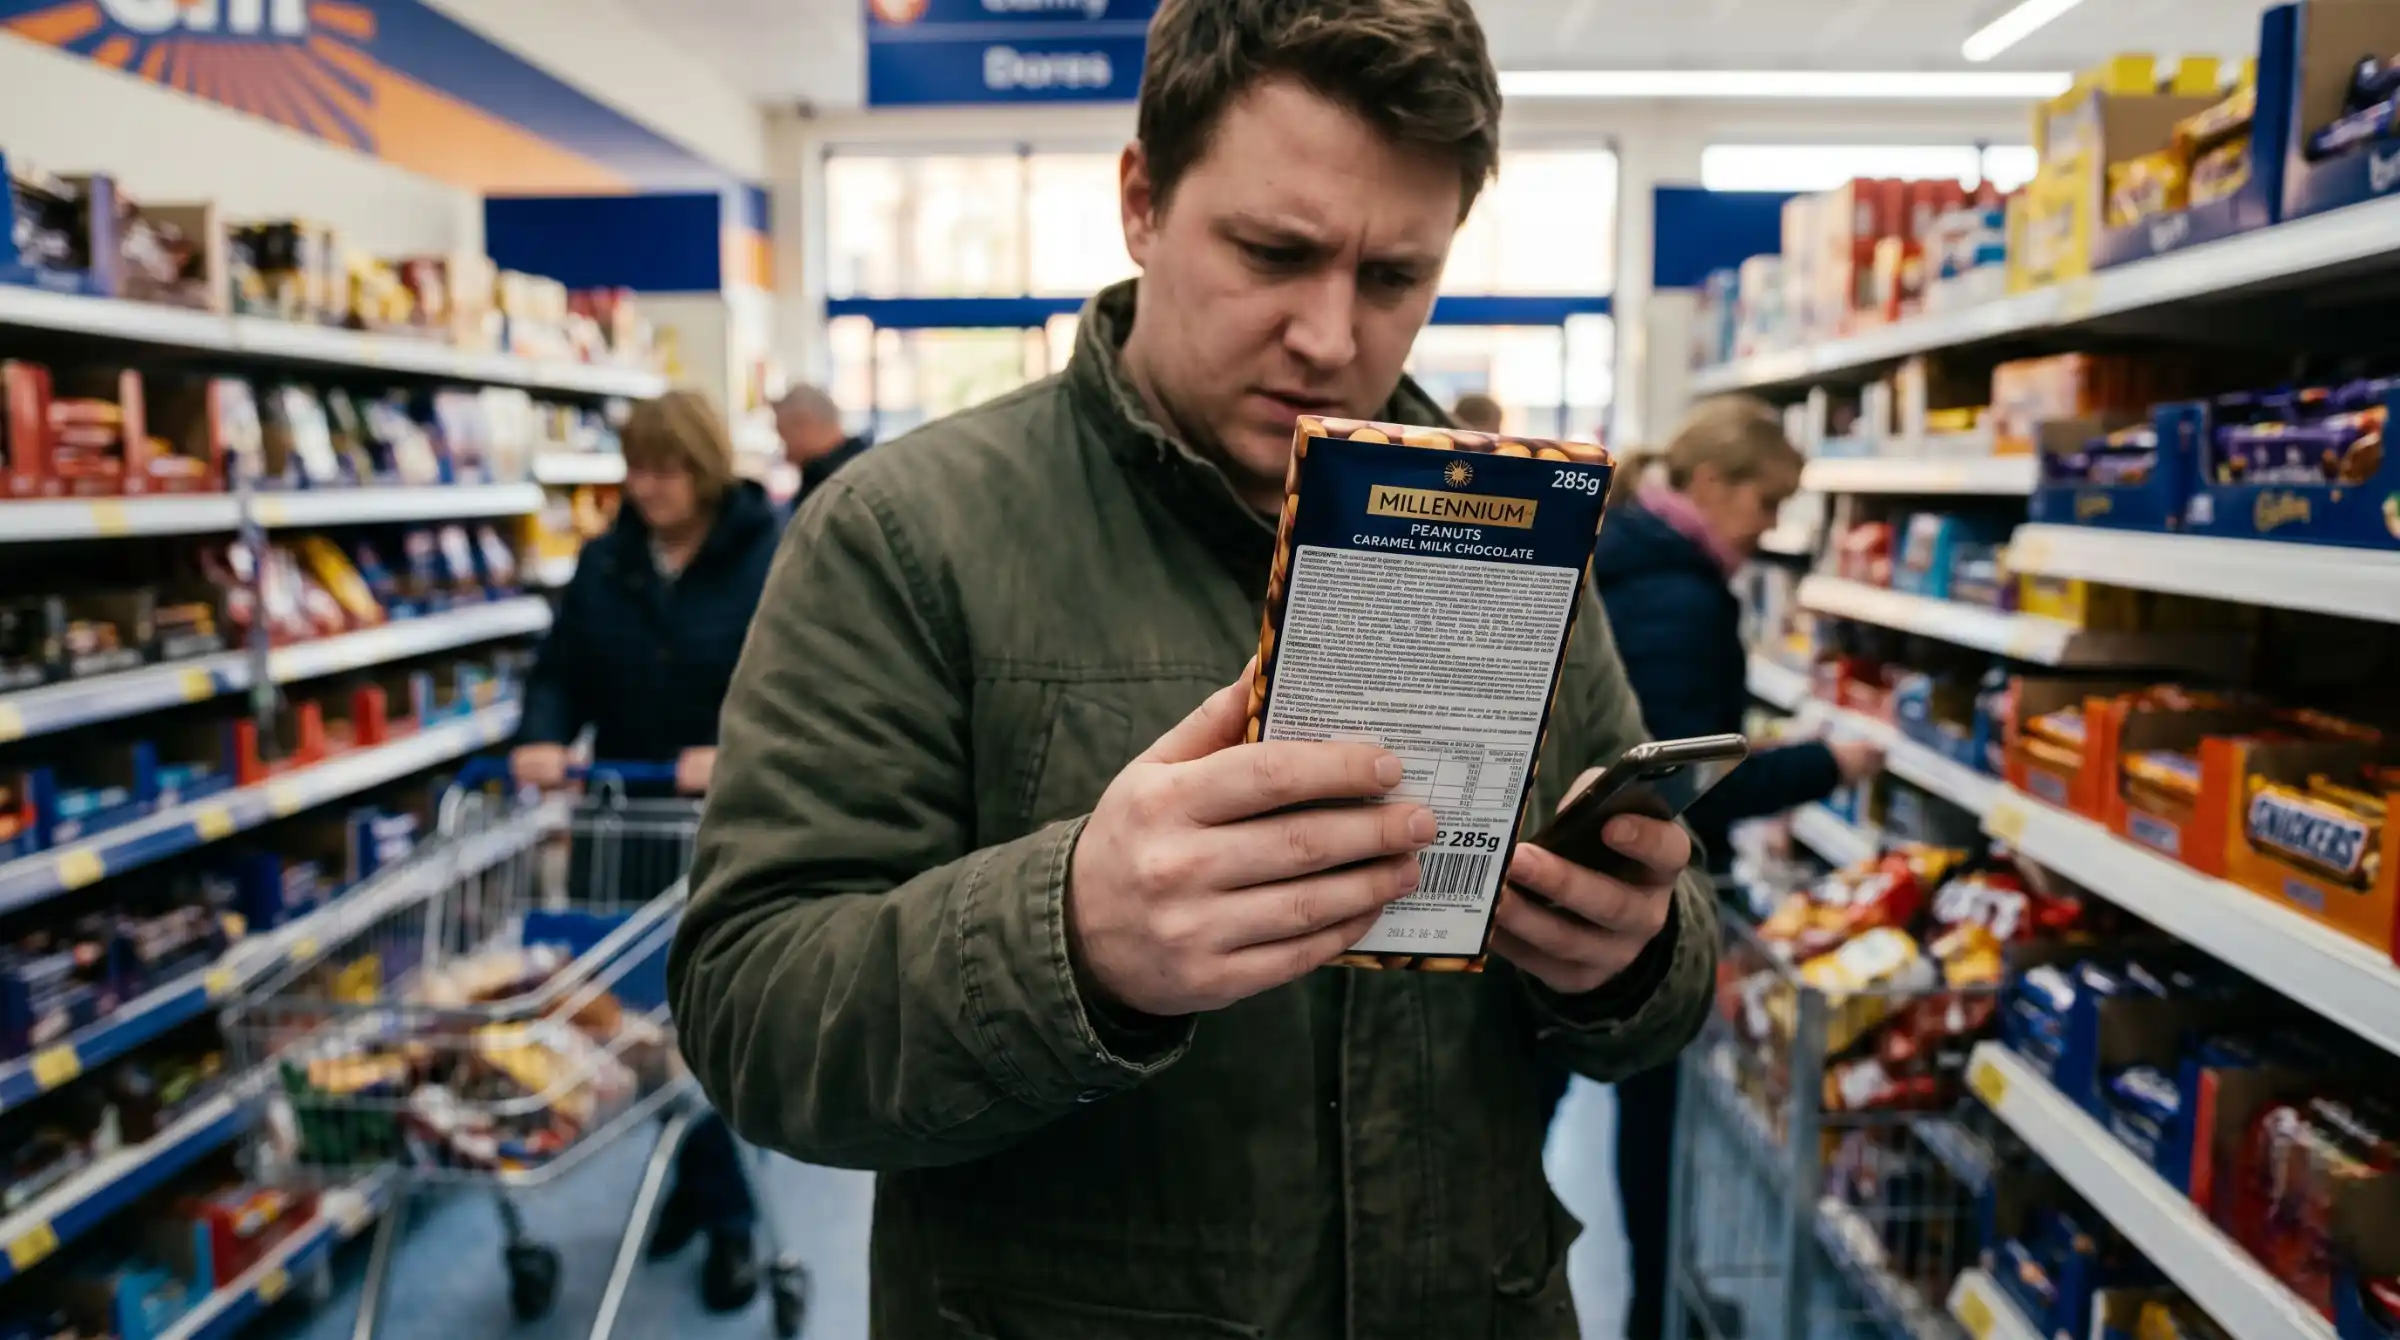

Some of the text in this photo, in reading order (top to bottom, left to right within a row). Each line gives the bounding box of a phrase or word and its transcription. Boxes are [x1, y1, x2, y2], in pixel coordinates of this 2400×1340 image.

[1551, 470, 1600, 495] 285g
[1379, 491, 1526, 523] MILLENNIUM
[1411, 524, 1482, 541] PEANUTS
[1352, 534, 1535, 560] CARAMEL MILK CHOCOLATE
[1449, 831, 1501, 852] 285g
